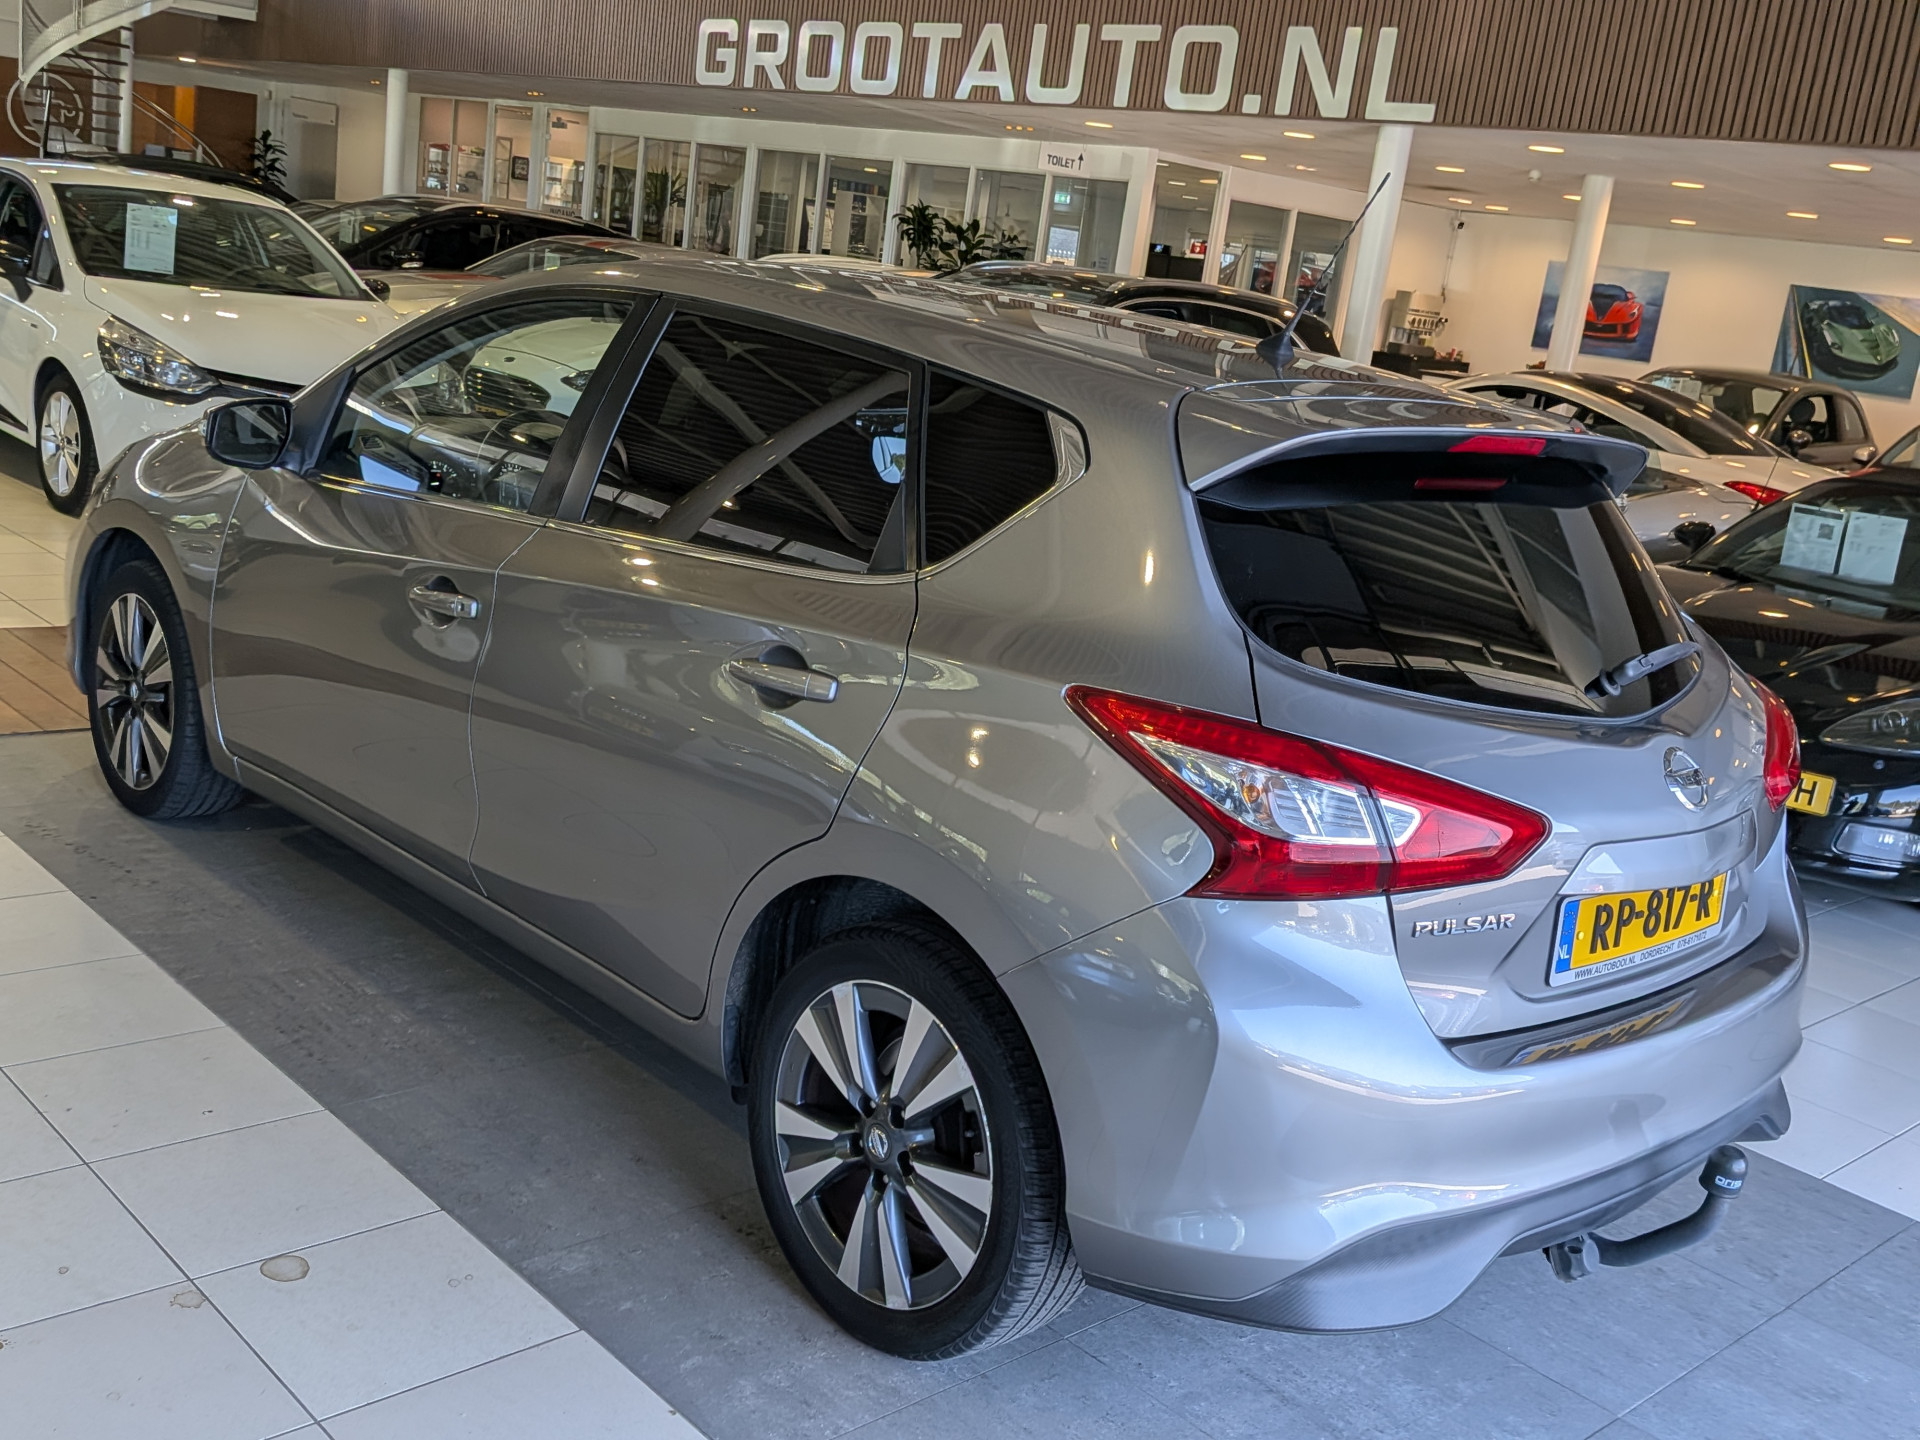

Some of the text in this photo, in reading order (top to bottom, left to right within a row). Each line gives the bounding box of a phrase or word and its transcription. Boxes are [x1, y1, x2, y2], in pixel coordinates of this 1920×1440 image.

[695, 18, 1436, 122] GROOTAUTO.NL
[1047, 153, 1076, 169] TOILET
[1412, 913, 1516, 938] PULSAR
[1589, 878, 1715, 954] RP-817-R
[1640, 943, 1675, 961] DORDRECHT
